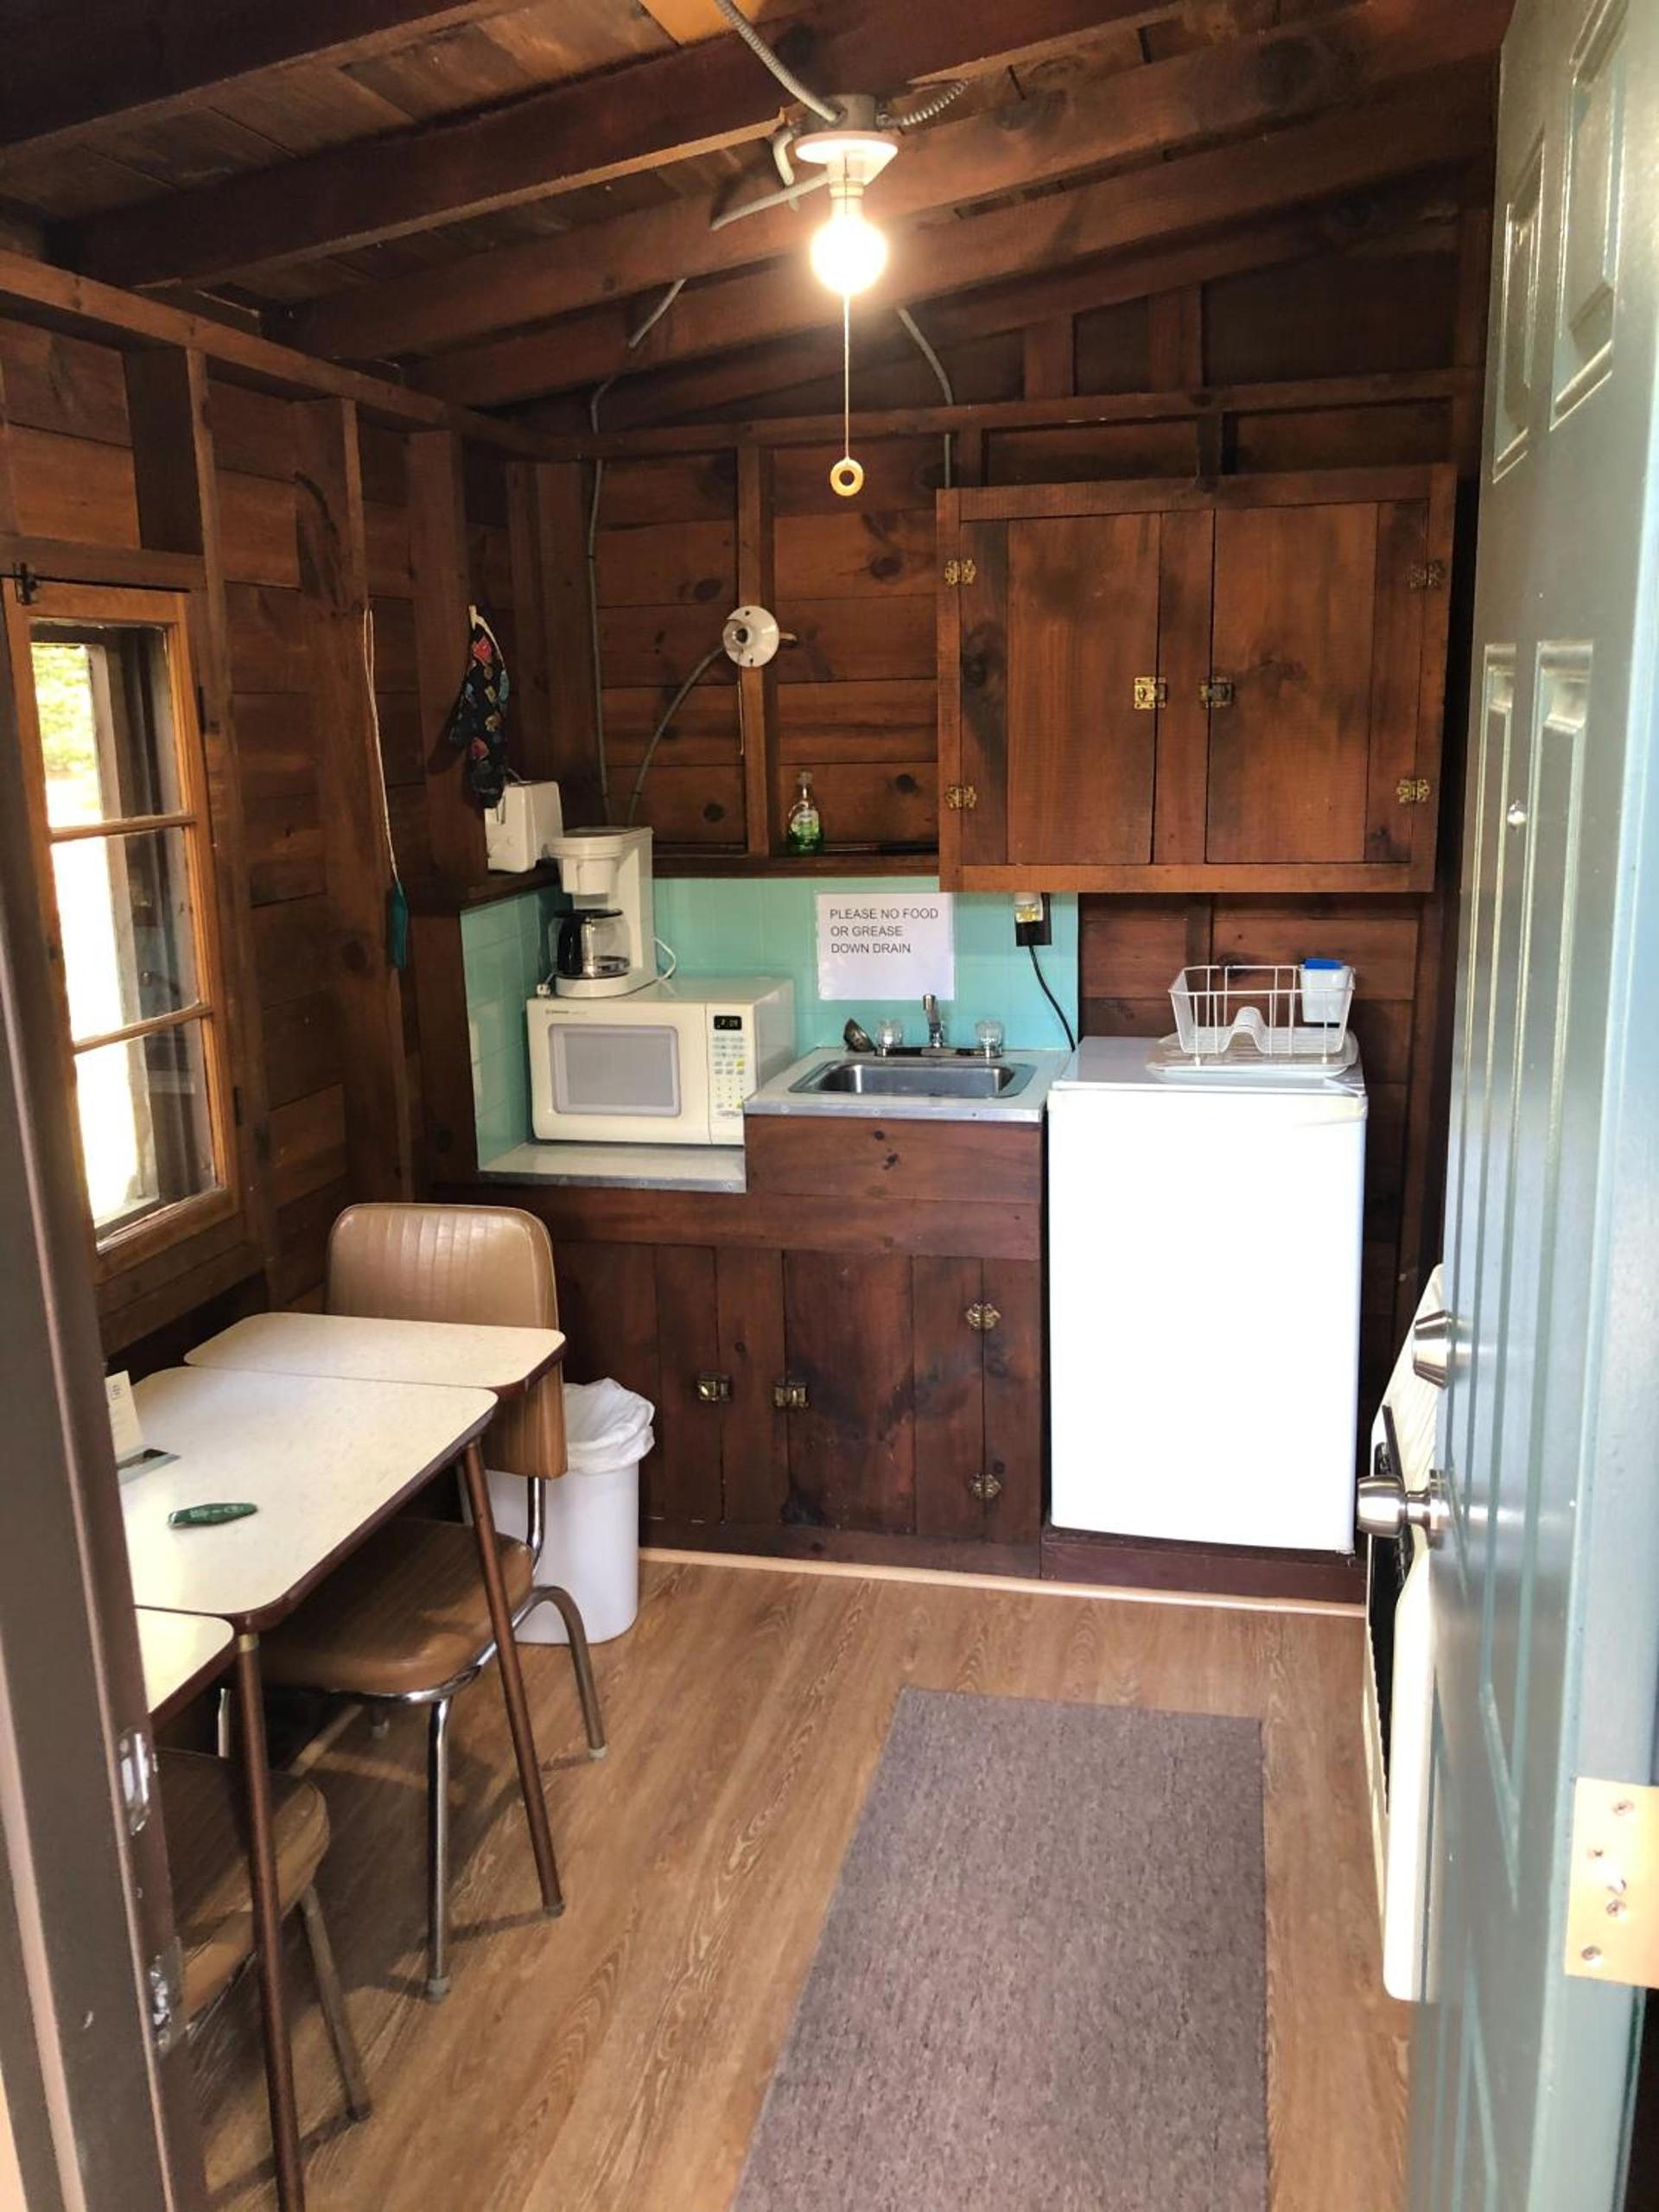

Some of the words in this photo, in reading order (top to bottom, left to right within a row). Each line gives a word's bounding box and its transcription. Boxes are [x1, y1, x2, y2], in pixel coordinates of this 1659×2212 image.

[830, 908, 878, 919] PLEASE
[880, 908, 899, 919] NO
[903, 908, 938, 919] FOOD
[830, 925, 849, 937] OR
[852, 925, 903, 937] GREASE
[831, 943, 869, 954] DOWN
[873, 943, 911, 954] DRAIN
